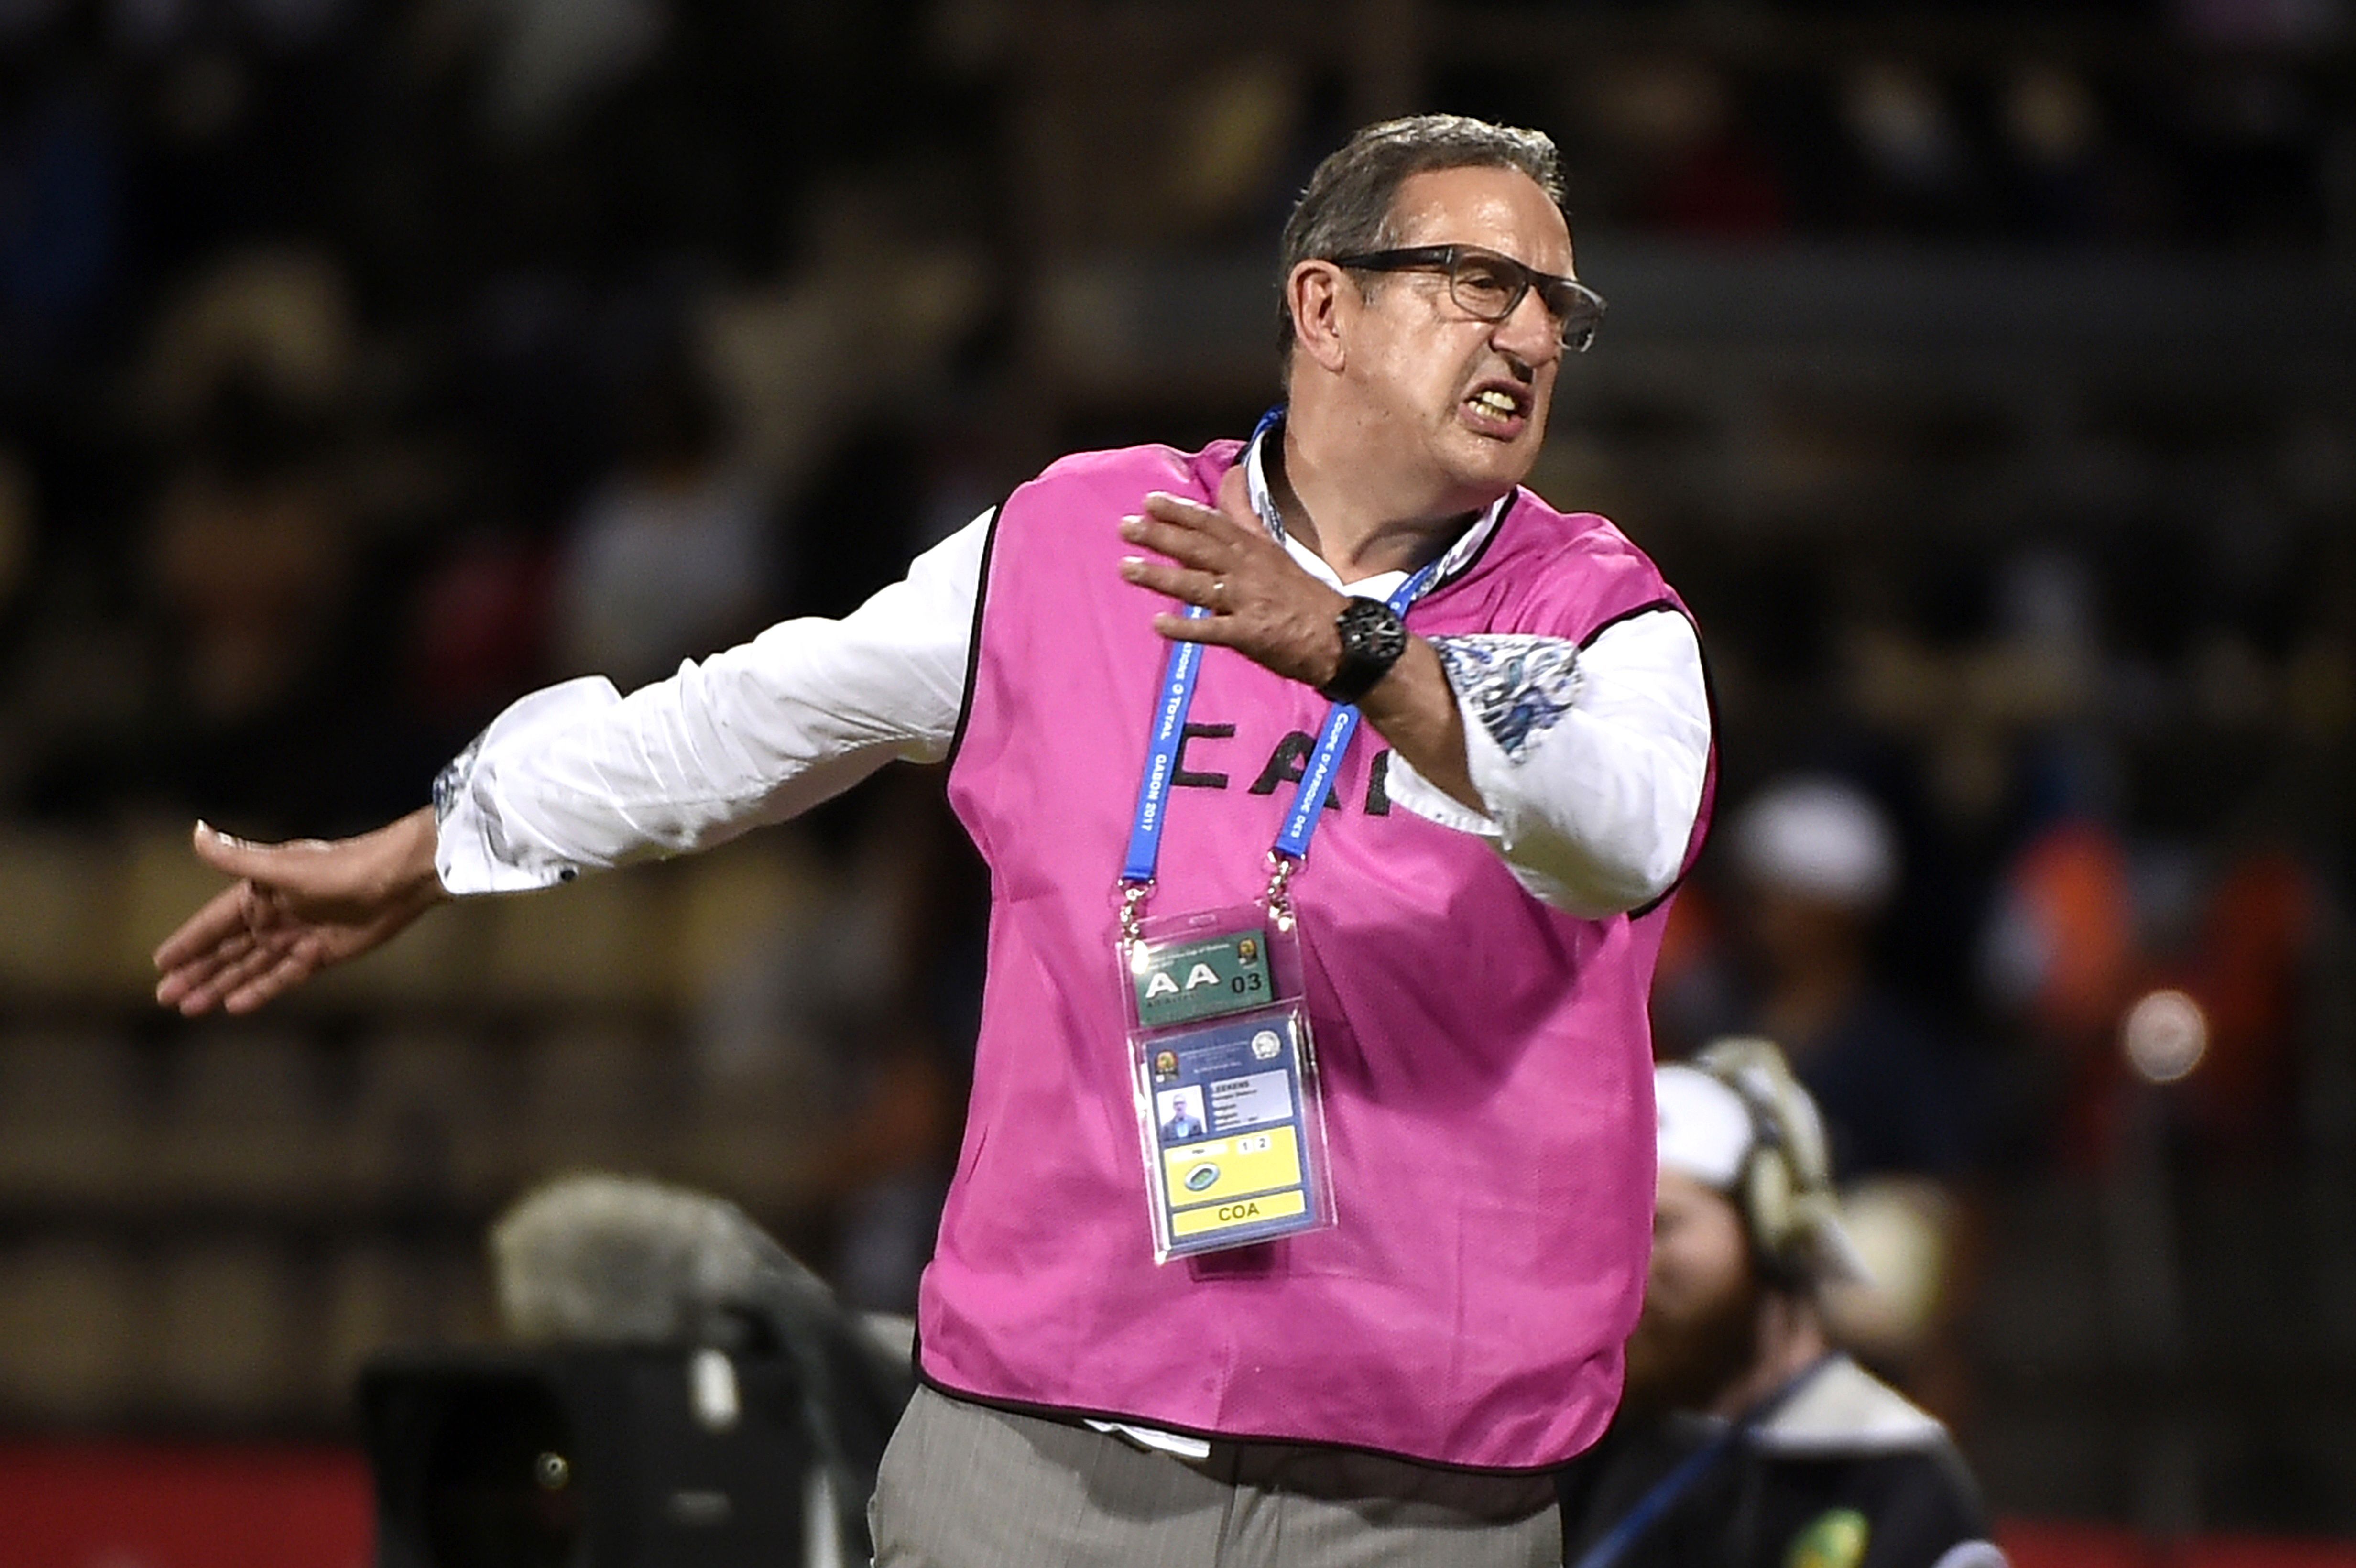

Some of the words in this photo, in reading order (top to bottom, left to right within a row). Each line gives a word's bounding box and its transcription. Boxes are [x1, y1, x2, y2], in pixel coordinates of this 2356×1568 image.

[1175, 642, 1193, 680] ATIONS
[1160, 697, 1182, 740] TOTAL
[1147, 754, 1167, 800] GABON
[1141, 802, 1157, 831] 2017
[1232, 972, 1262, 994] 03
[1259, 1138, 1266, 1148] 2
[1218, 1202, 1260, 1221] COA
